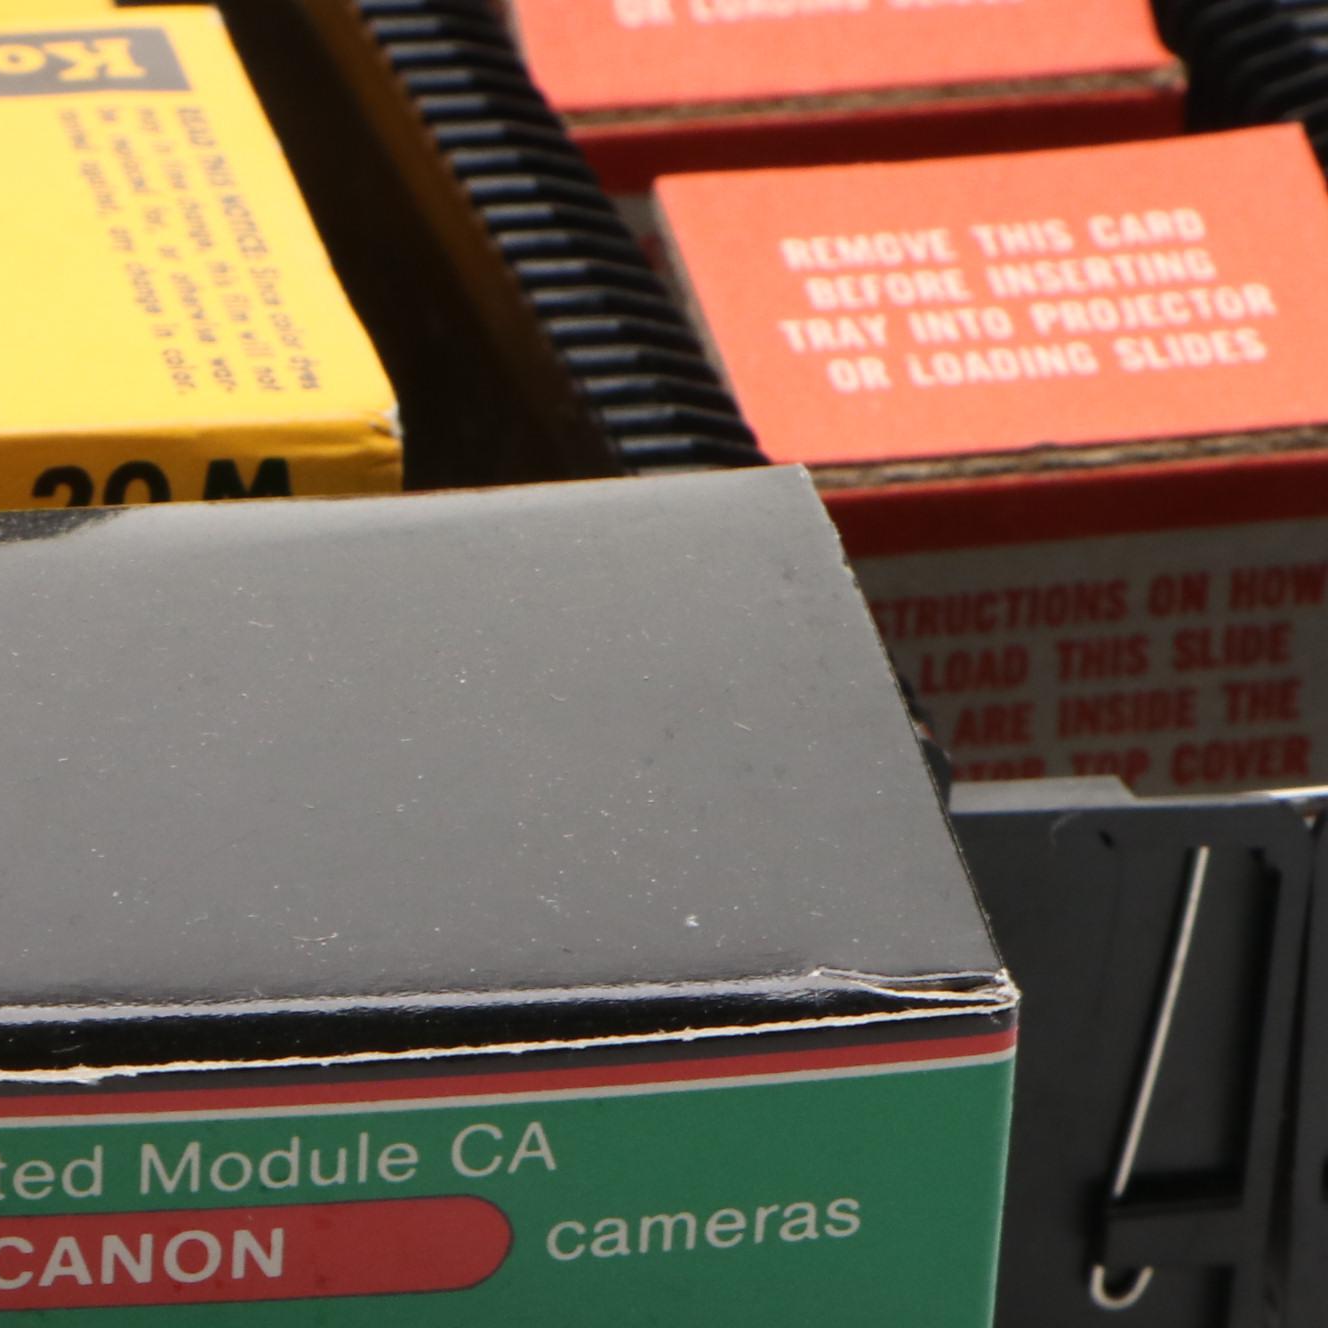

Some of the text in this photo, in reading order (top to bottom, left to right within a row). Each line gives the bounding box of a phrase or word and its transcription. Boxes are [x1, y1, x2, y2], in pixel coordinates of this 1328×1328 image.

[780, 207, 1206, 272] REMOVE THIS CARD
[804, 248, 1217, 311] BEFORE INSERTING
[778, 283, 1277, 354] TRAY INTO PROJECTOR
[826, 327, 1268, 393] OR LOADING SLIDES
[1147, 571, 1212, 618] ON
[1228, 563, 1328, 611] HOW
[919, 620, 1294, 696] LOAD THIS SLIDE
[953, 677, 1304, 748] ARE INSIDE THE
[1170, 734, 1313, 786] COVER
[139, 1132, 419, 1196] Module
[451, 1121, 557, 1178] CA
[546, 1198, 862, 1261] cameras
